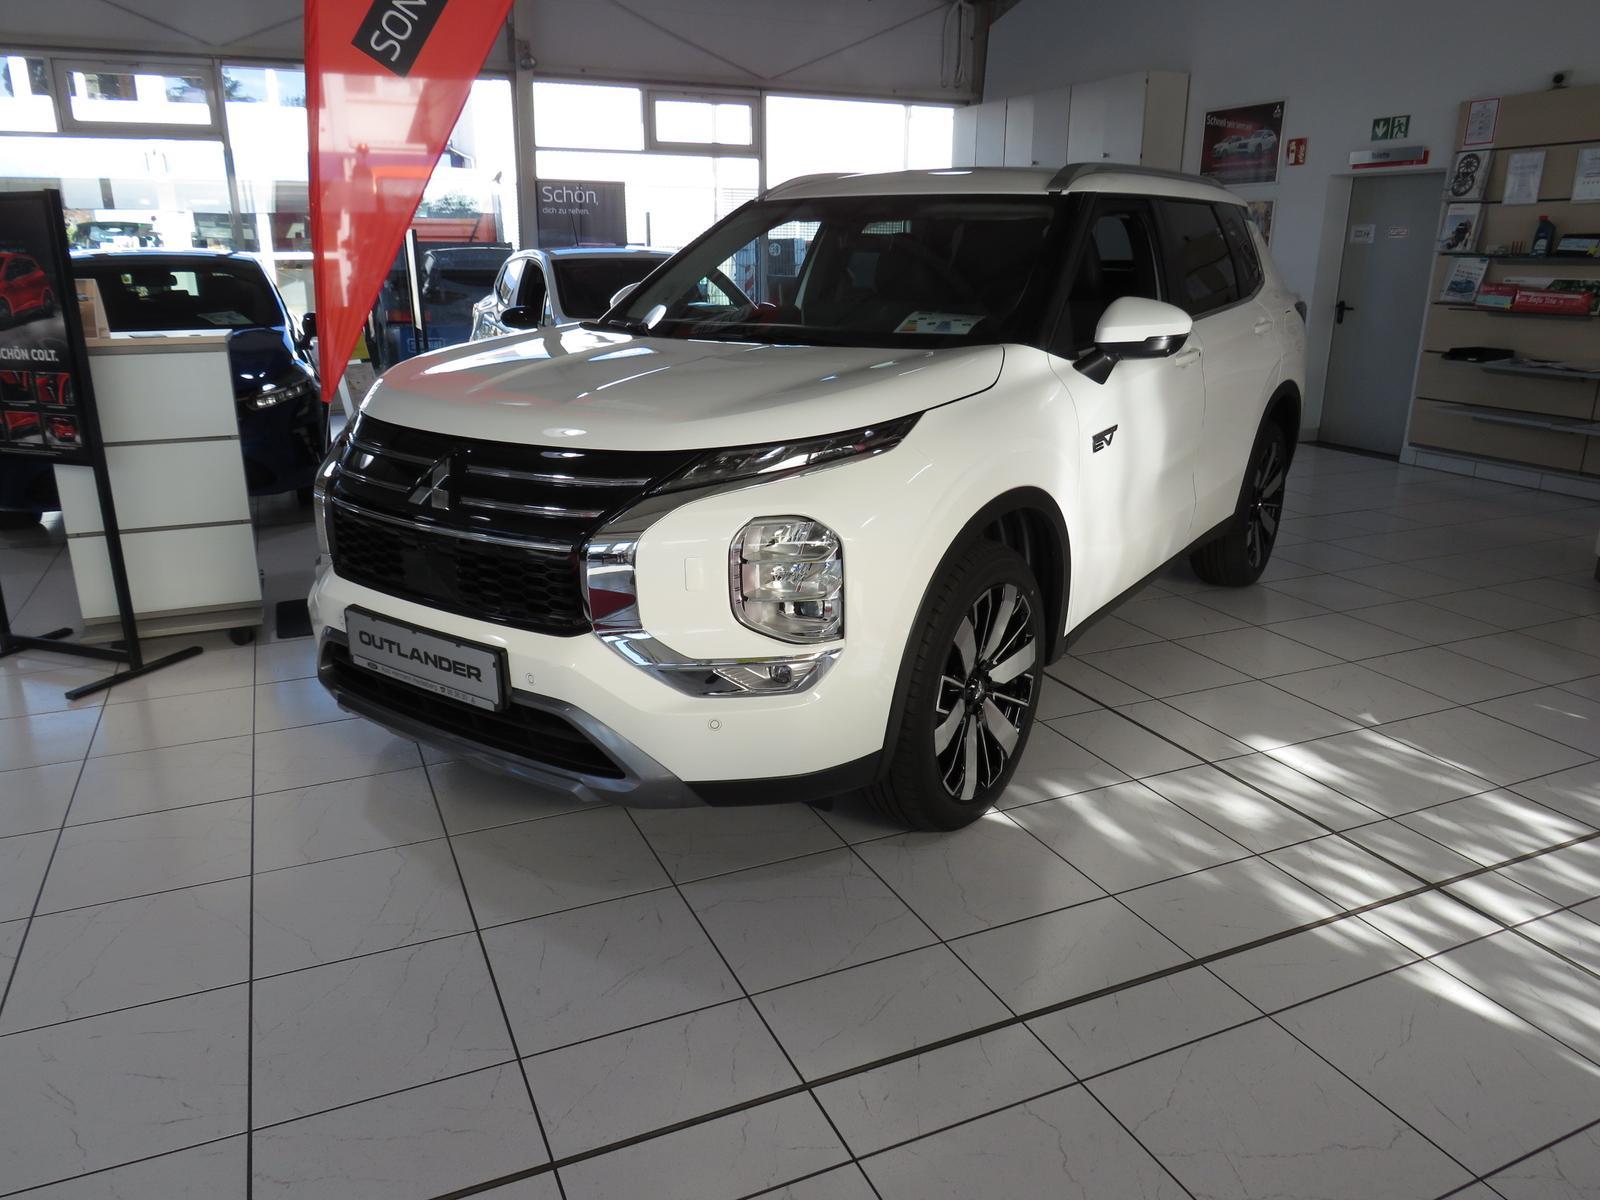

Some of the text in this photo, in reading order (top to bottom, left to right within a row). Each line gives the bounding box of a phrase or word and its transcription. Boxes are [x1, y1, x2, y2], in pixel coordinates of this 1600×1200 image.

[542, 186, 599, 206] Schön,
[0, 345, 60, 362] CHÖN COLT.
[359, 630, 482, 682] OUTLANDER
